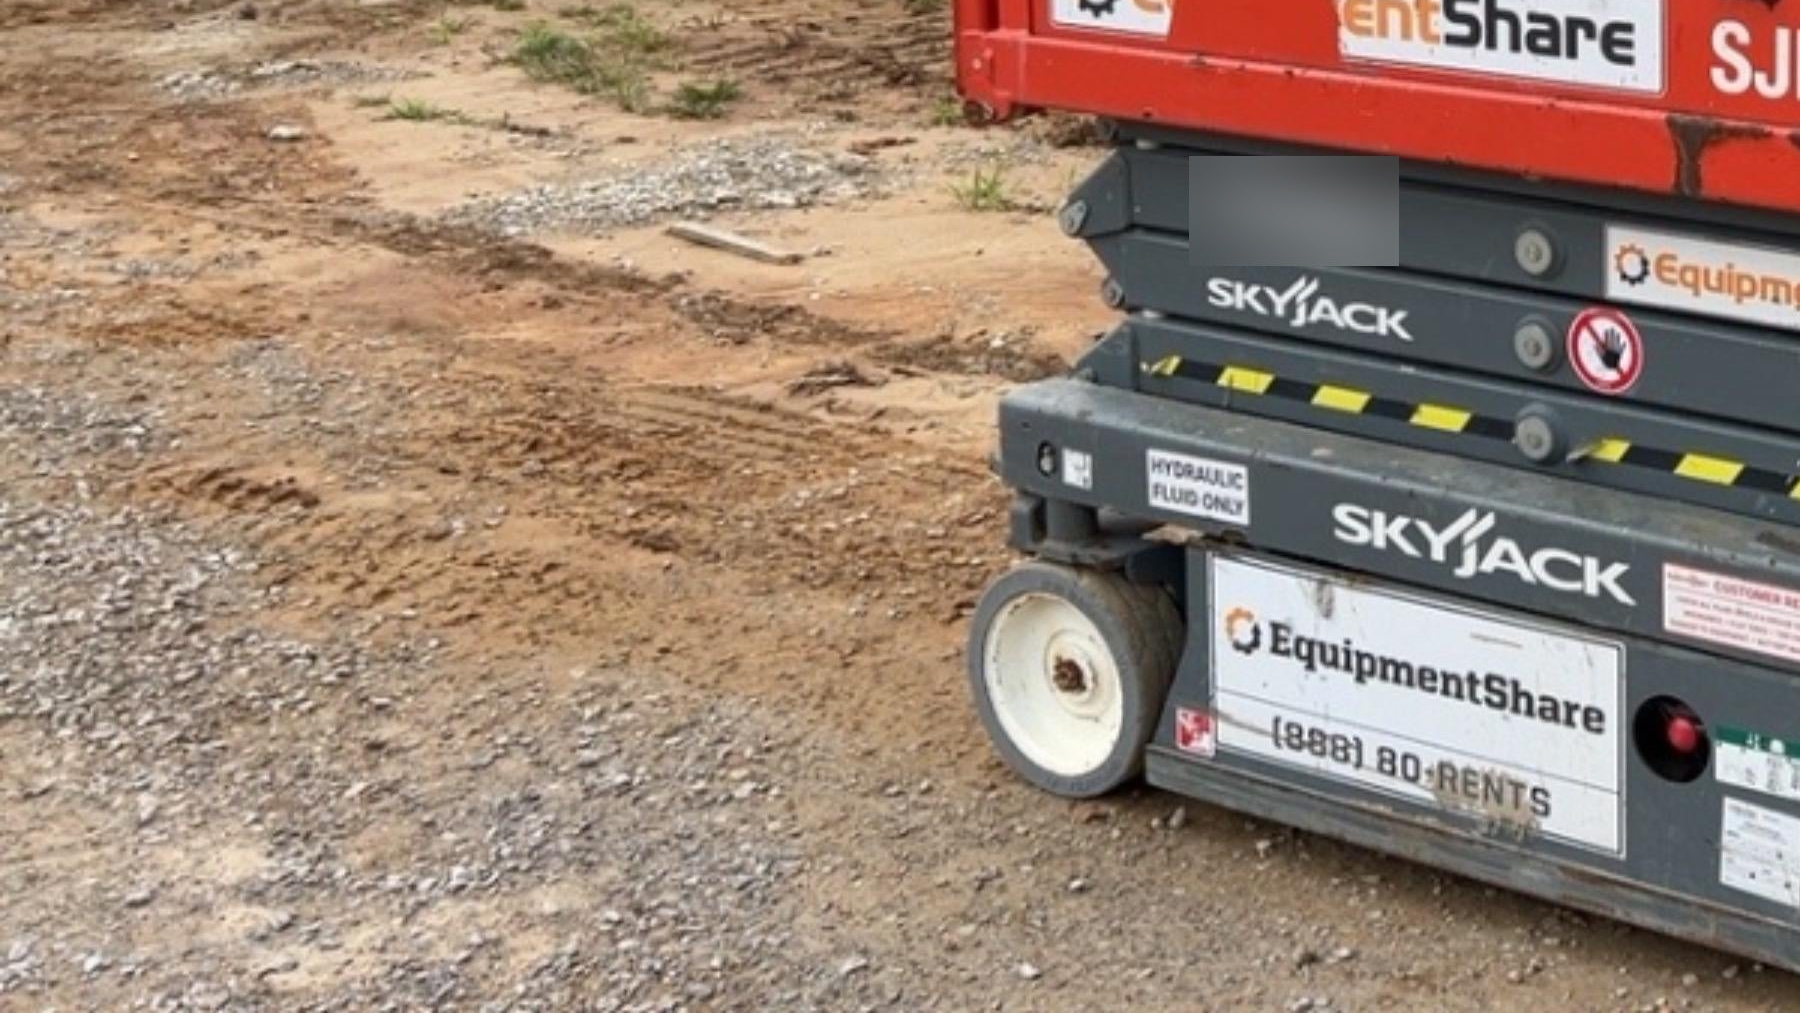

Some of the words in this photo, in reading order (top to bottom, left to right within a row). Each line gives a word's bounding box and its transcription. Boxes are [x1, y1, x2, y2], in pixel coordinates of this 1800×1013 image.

[1206, 275, 1414, 341] SKYJACK
[1151, 456, 1243, 491] HYDRAULIC
[1152, 482, 1198, 507] FLUID
[1202, 492, 1243, 516] ONLY
[1331, 507, 1637, 606] SKYJACK
[1713, 579, 1780, 606] CUSTOMER
[1268, 620, 1606, 736] EquipmentShare
[1270, 715, 1364, 769] (888)
[1375, 744, 1552, 818] 80-RENTS
